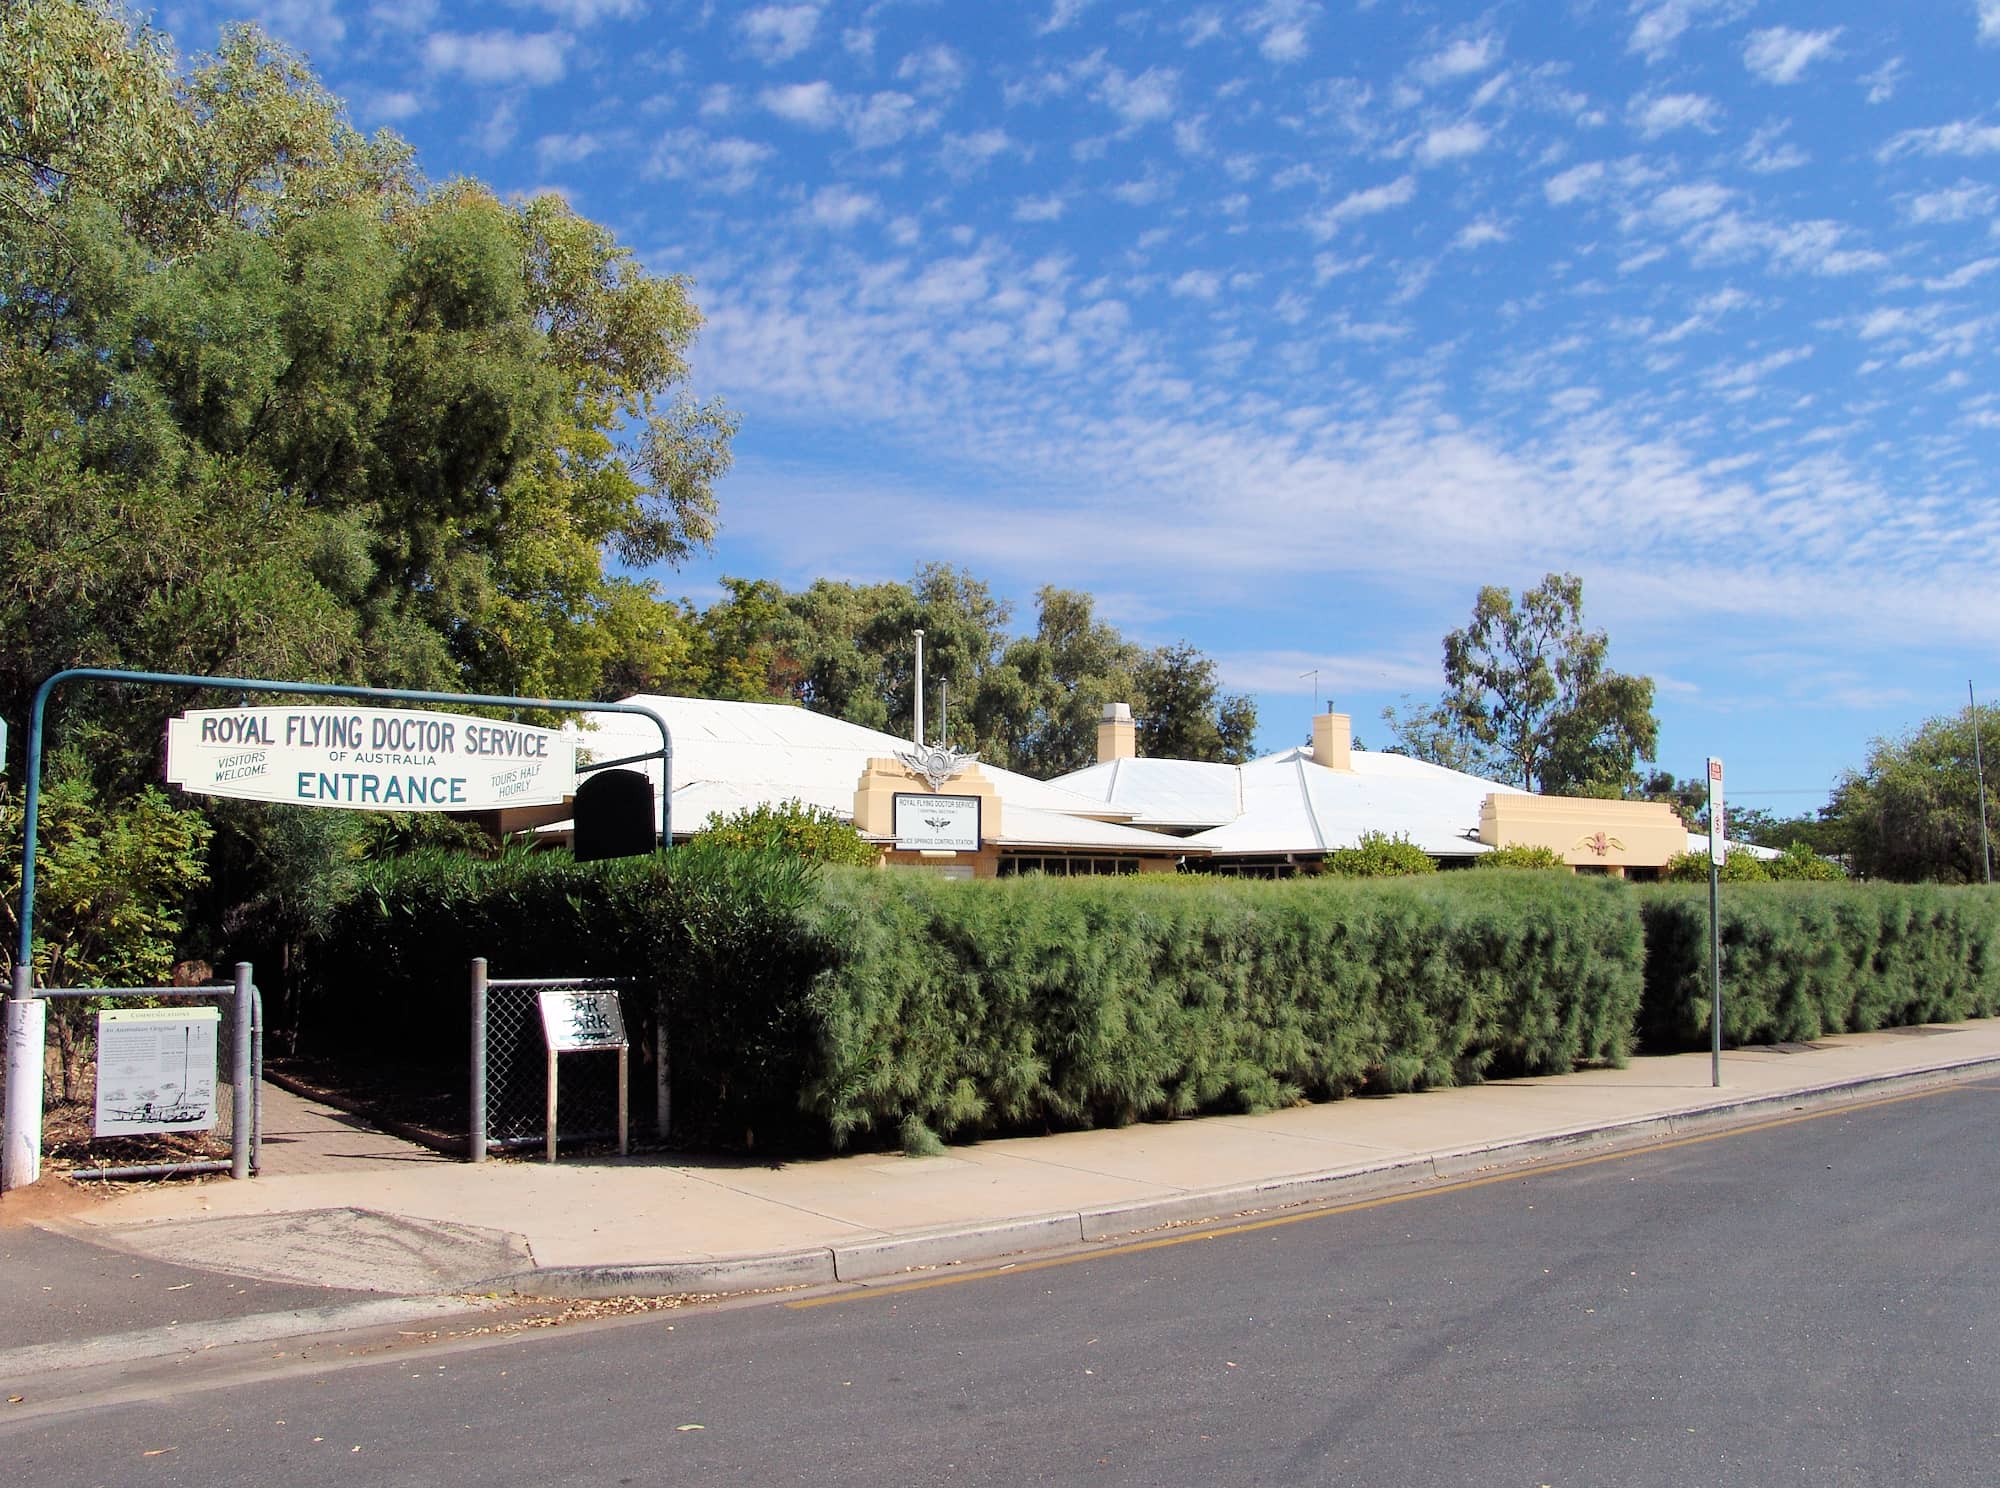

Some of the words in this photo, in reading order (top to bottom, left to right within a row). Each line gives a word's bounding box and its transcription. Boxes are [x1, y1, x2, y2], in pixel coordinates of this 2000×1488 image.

[202, 716, 275, 745] ROYAL
[286, 715, 363, 749] FLYING
[372, 718, 455, 753] DOCTOR
[465, 725, 549, 758] SERVICE
[218, 752, 266, 768] VISITORS
[329, 751, 348, 762] OF
[354, 752, 436, 766] AUSTRALIA
[215, 764, 268, 782] WELCOME
[491, 771, 518, 788] TOURS
[520, 764, 542, 778] HALF
[298, 772, 467, 803] ENTRANCE
[499, 779, 531, 798] HOURLY
[899, 798, 916, 806] ROYAL
[917, 799, 935, 807] FLYING
[935, 800, 955, 808] DOCTOR
